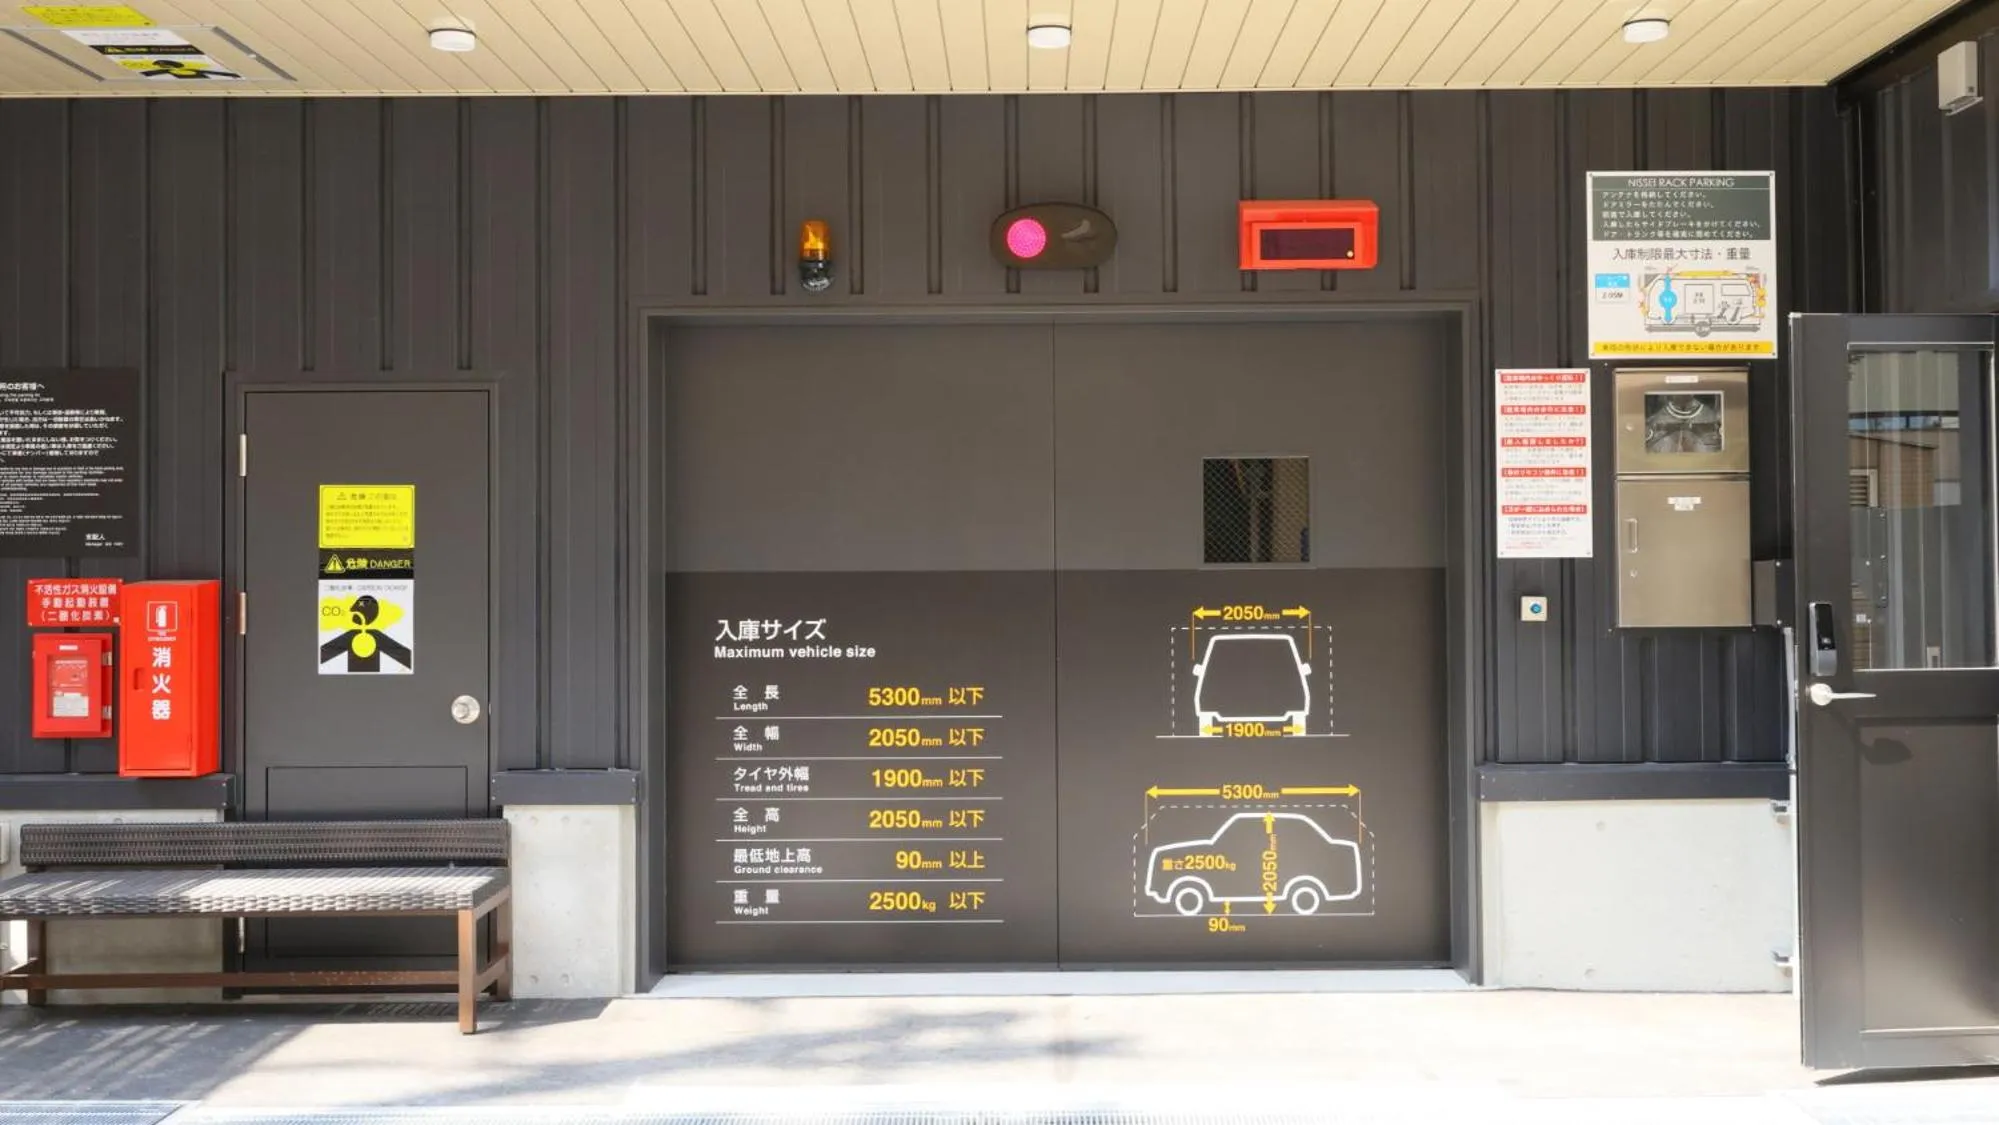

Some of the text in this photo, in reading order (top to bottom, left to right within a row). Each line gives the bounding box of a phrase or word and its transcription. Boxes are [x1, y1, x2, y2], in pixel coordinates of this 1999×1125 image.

[1628, 178, 1736, 188] NISSEI RACK PARKING
[1612, 247, 1751, 261] 入庫制限最大寸法・重量
[345, 558, 411, 569] 危険 DANGER
[35, 584, 117, 595] 不活性ガス消火設備
[41, 597, 109, 608] 手動起動装置
[1223, 605, 1280, 621] 2050mm
[715, 618, 827, 642] 入庫サイズ
[714, 644, 876, 658] Maximum vehicle size
[151, 646, 172, 721] 消火器
[868, 687, 942, 706] 5300mm
[948, 687, 985, 705] 以下
[733, 702, 769, 712] Length
[868, 728, 943, 747] 2050mm
[948, 728, 985, 746] 以下
[1225, 722, 1282, 738] 1900mm
[733, 742, 763, 752] Width
[733, 766, 985, 788] タイヤ外幅 1900mm 以下
[733, 784, 810, 793] Tread and tires
[1222, 784, 1280, 800] 5300mm
[869, 810, 943, 829] 2050mm
[948, 809, 985, 828] 以下
[733, 824, 767, 834] Height
[733, 848, 986, 869] 最低地上高 90mm 以上
[1261, 833, 1279, 893] 2050mm
[733, 865, 823, 875] Ground clearance
[869, 891, 937, 913] 2500kg
[949, 892, 986, 910] 以下
[733, 906, 769, 917] Weight
[1208, 917, 1247, 933] 90mm
